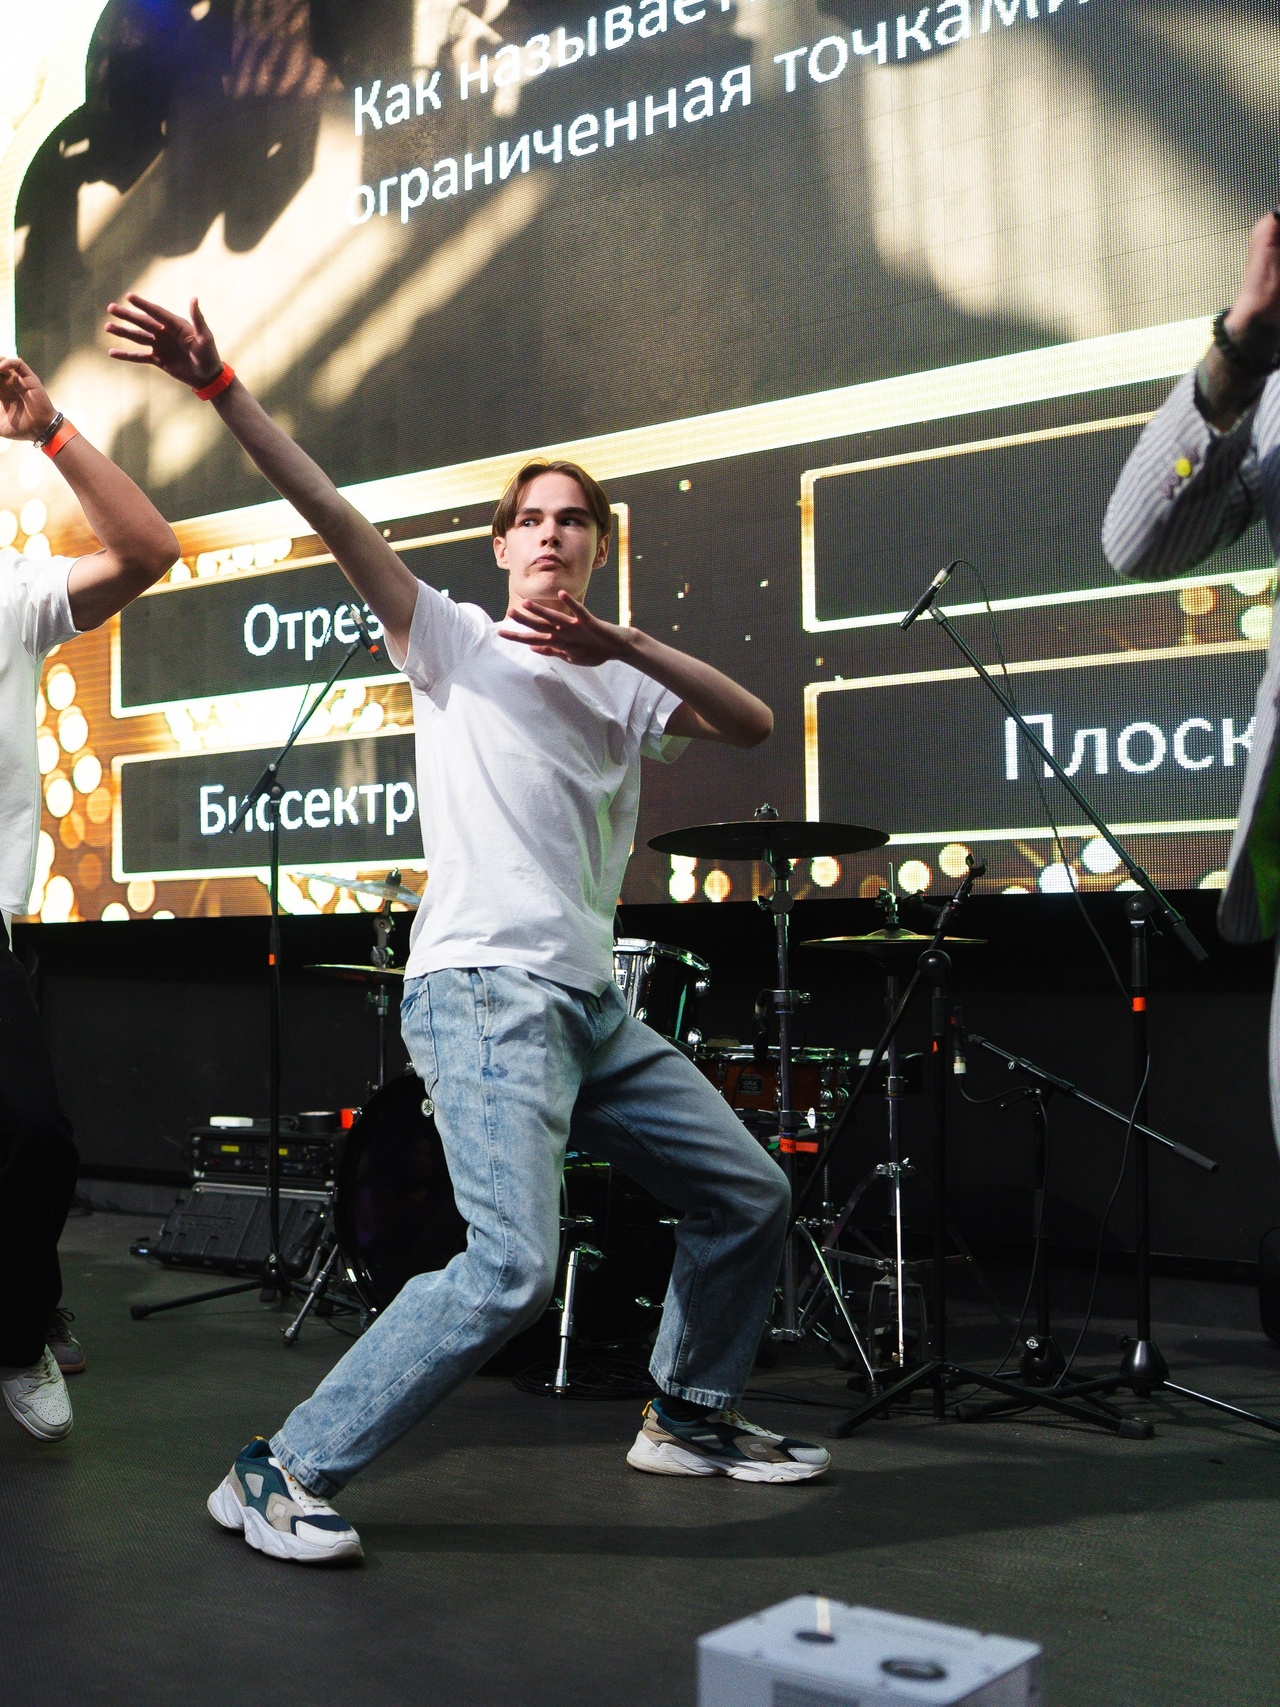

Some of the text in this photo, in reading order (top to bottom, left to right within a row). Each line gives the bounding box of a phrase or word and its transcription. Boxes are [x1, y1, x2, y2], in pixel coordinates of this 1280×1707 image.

[346, 0, 1089, 225] ограниченная точкам
[353, 0, 731, 137] Как называе
[1003, 713, 1258, 781] Плоск
[199, 781, 416, 836] Биссектр
